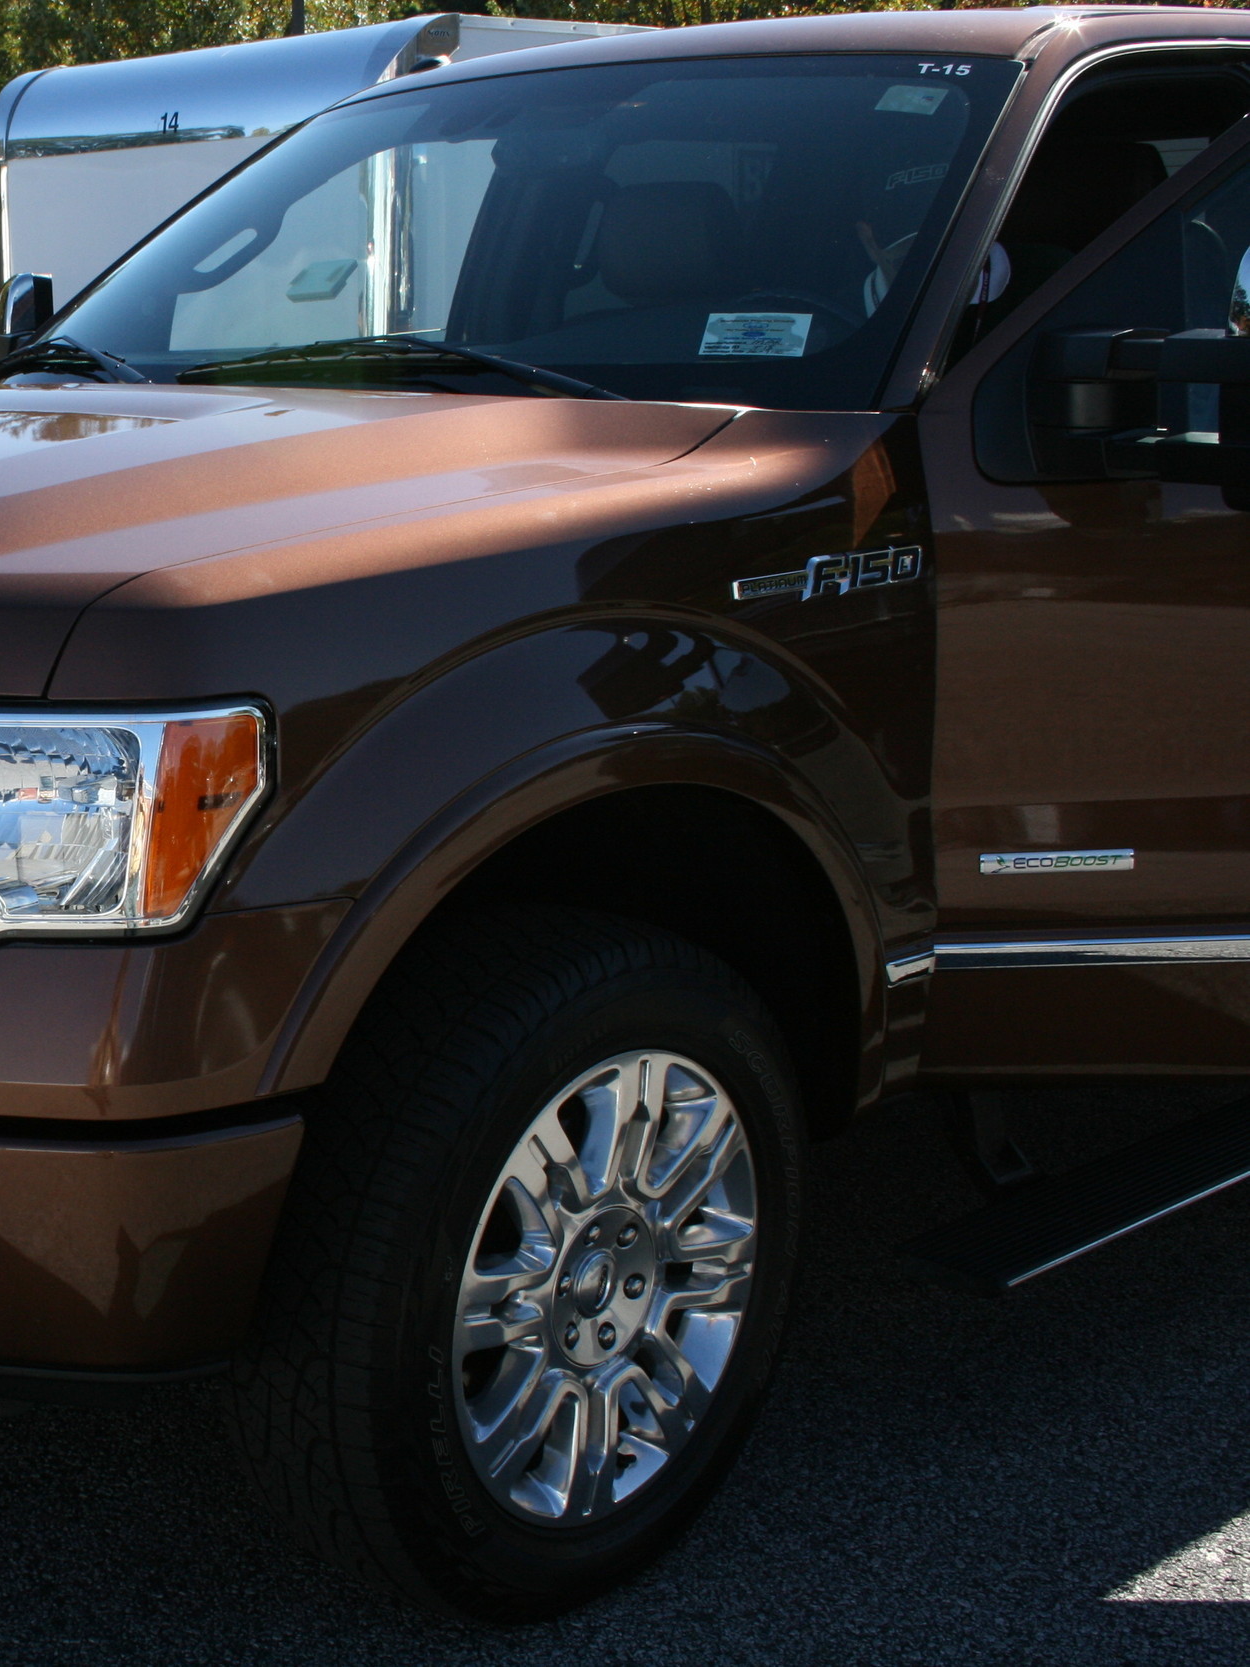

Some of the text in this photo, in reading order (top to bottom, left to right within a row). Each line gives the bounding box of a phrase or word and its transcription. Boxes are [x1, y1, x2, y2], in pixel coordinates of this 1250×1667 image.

[917, 63, 972, 76] T-15
[160, 111, 180, 135] 14
[427, 1344, 487, 1538] PIRELLI
